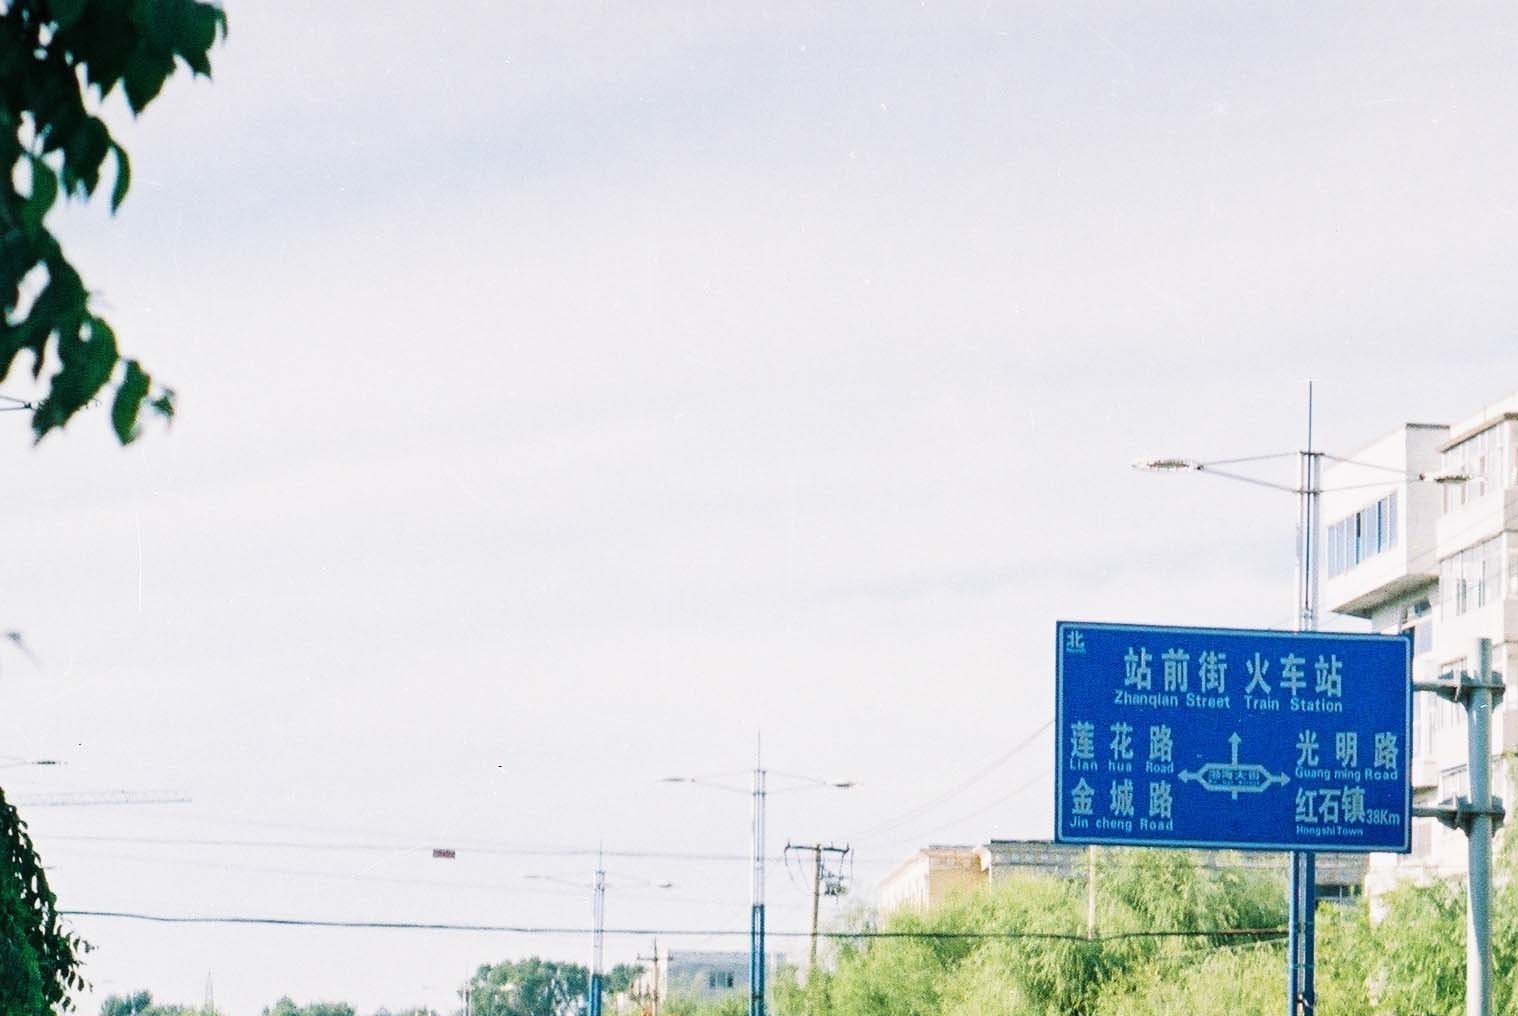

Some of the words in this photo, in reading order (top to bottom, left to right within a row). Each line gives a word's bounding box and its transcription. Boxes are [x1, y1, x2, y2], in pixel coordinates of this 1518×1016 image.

[1066, 631, 1085, 648] 北
[1124, 647, 1227, 693] 站前街
[1245, 652, 1343, 698] 火车站
[1115, 690, 1178, 708] Zhanqian
[1186, 692, 1231, 709] Street
[1244, 695, 1279, 711] Train
[1290, 696, 1343, 713] Station
[1071, 721, 1173, 762] 莲花路
[1296, 729, 1399, 770] 光明路
[1070, 758, 1098, 771] Lian
[1108, 760, 1132, 773] hua
[1146, 760, 1174, 774] Road
[1295, 766, 1331, 781] Guang
[1334, 768, 1360, 783] ming
[1365, 768, 1398, 780] Road
[1071, 777, 1174, 819] 金城路
[1295, 785, 1365, 824] 红石镇
[1366, 808, 1400, 826] 38Km
[1070, 816, 1089, 829] Jin
[1096, 817, 1132, 833] cheng
[1140, 817, 1173, 832] Road
